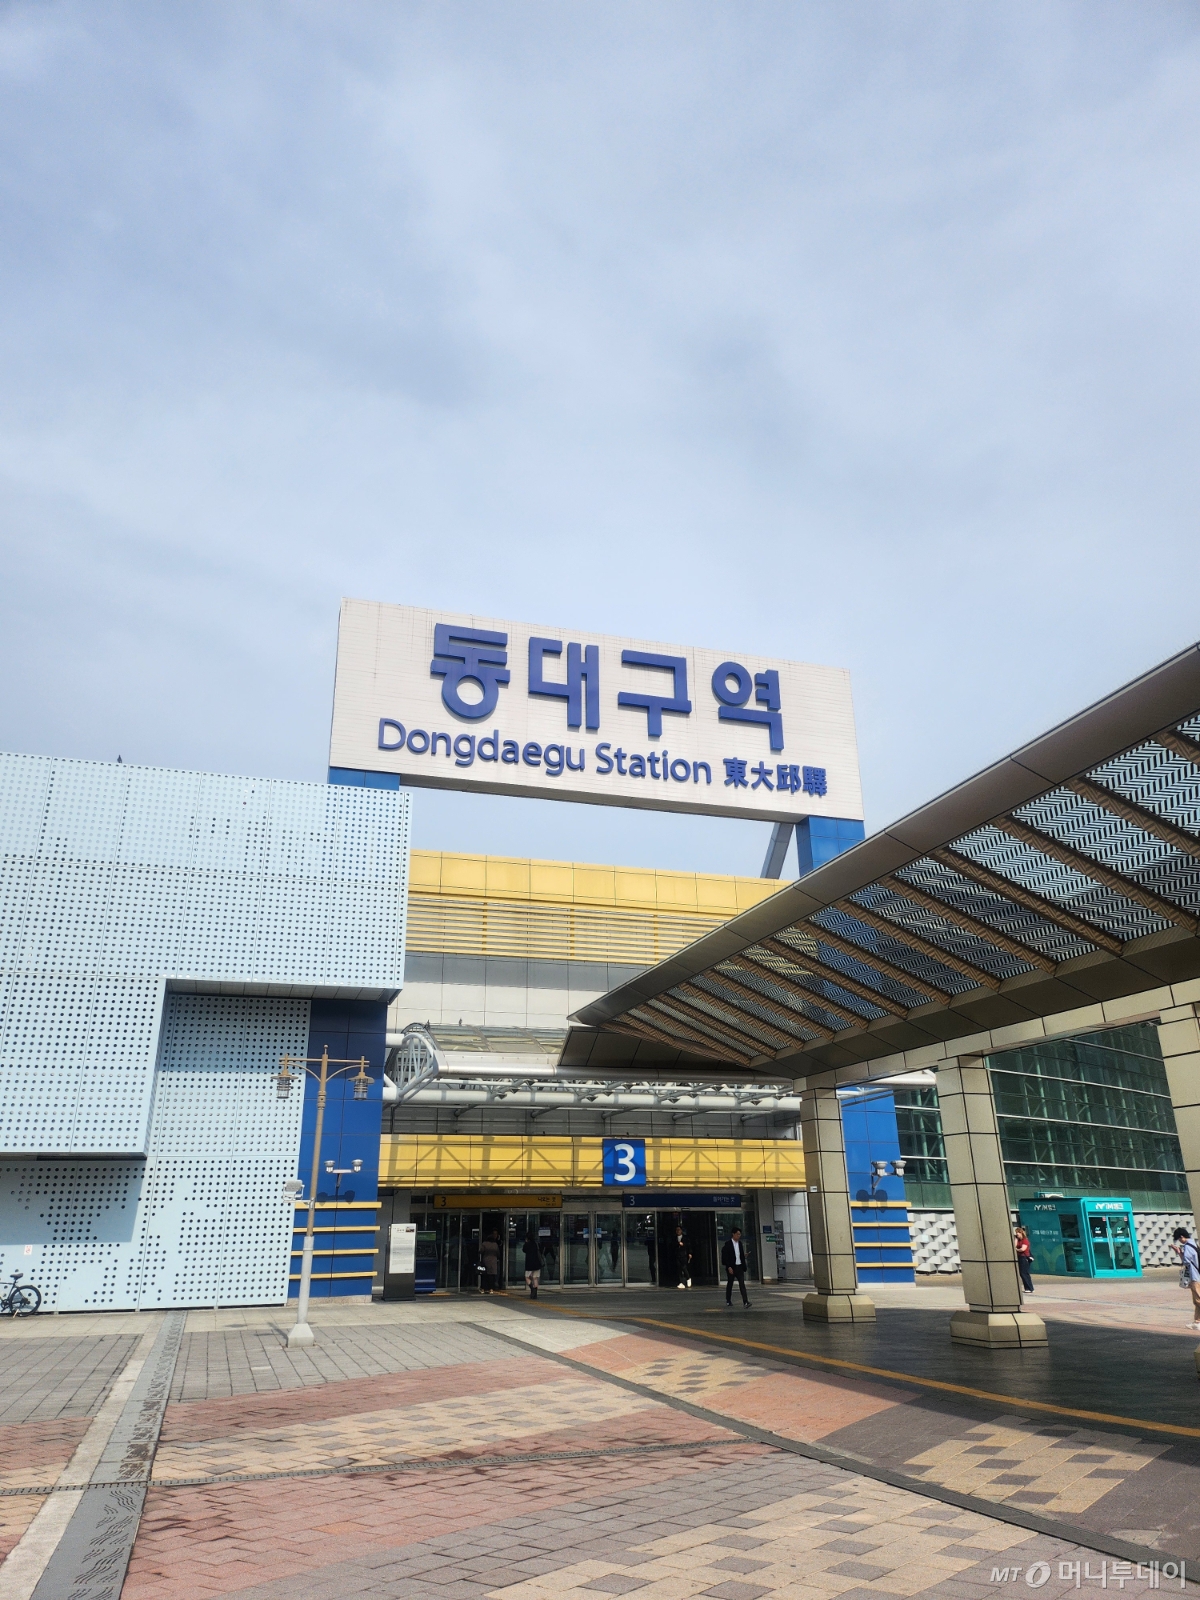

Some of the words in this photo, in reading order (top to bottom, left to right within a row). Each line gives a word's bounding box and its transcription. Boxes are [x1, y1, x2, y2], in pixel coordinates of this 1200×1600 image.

[430, 622, 785, 752] 동대구역
[378, 718, 586, 776] Dongdaegu
[596, 742, 713, 784] Station
[723, 756, 827, 797] 東大邱驛
[613, 1143, 636, 1182] 3
[440, 1196, 447, 1207] 3
[629, 1195, 636, 1206] 3
